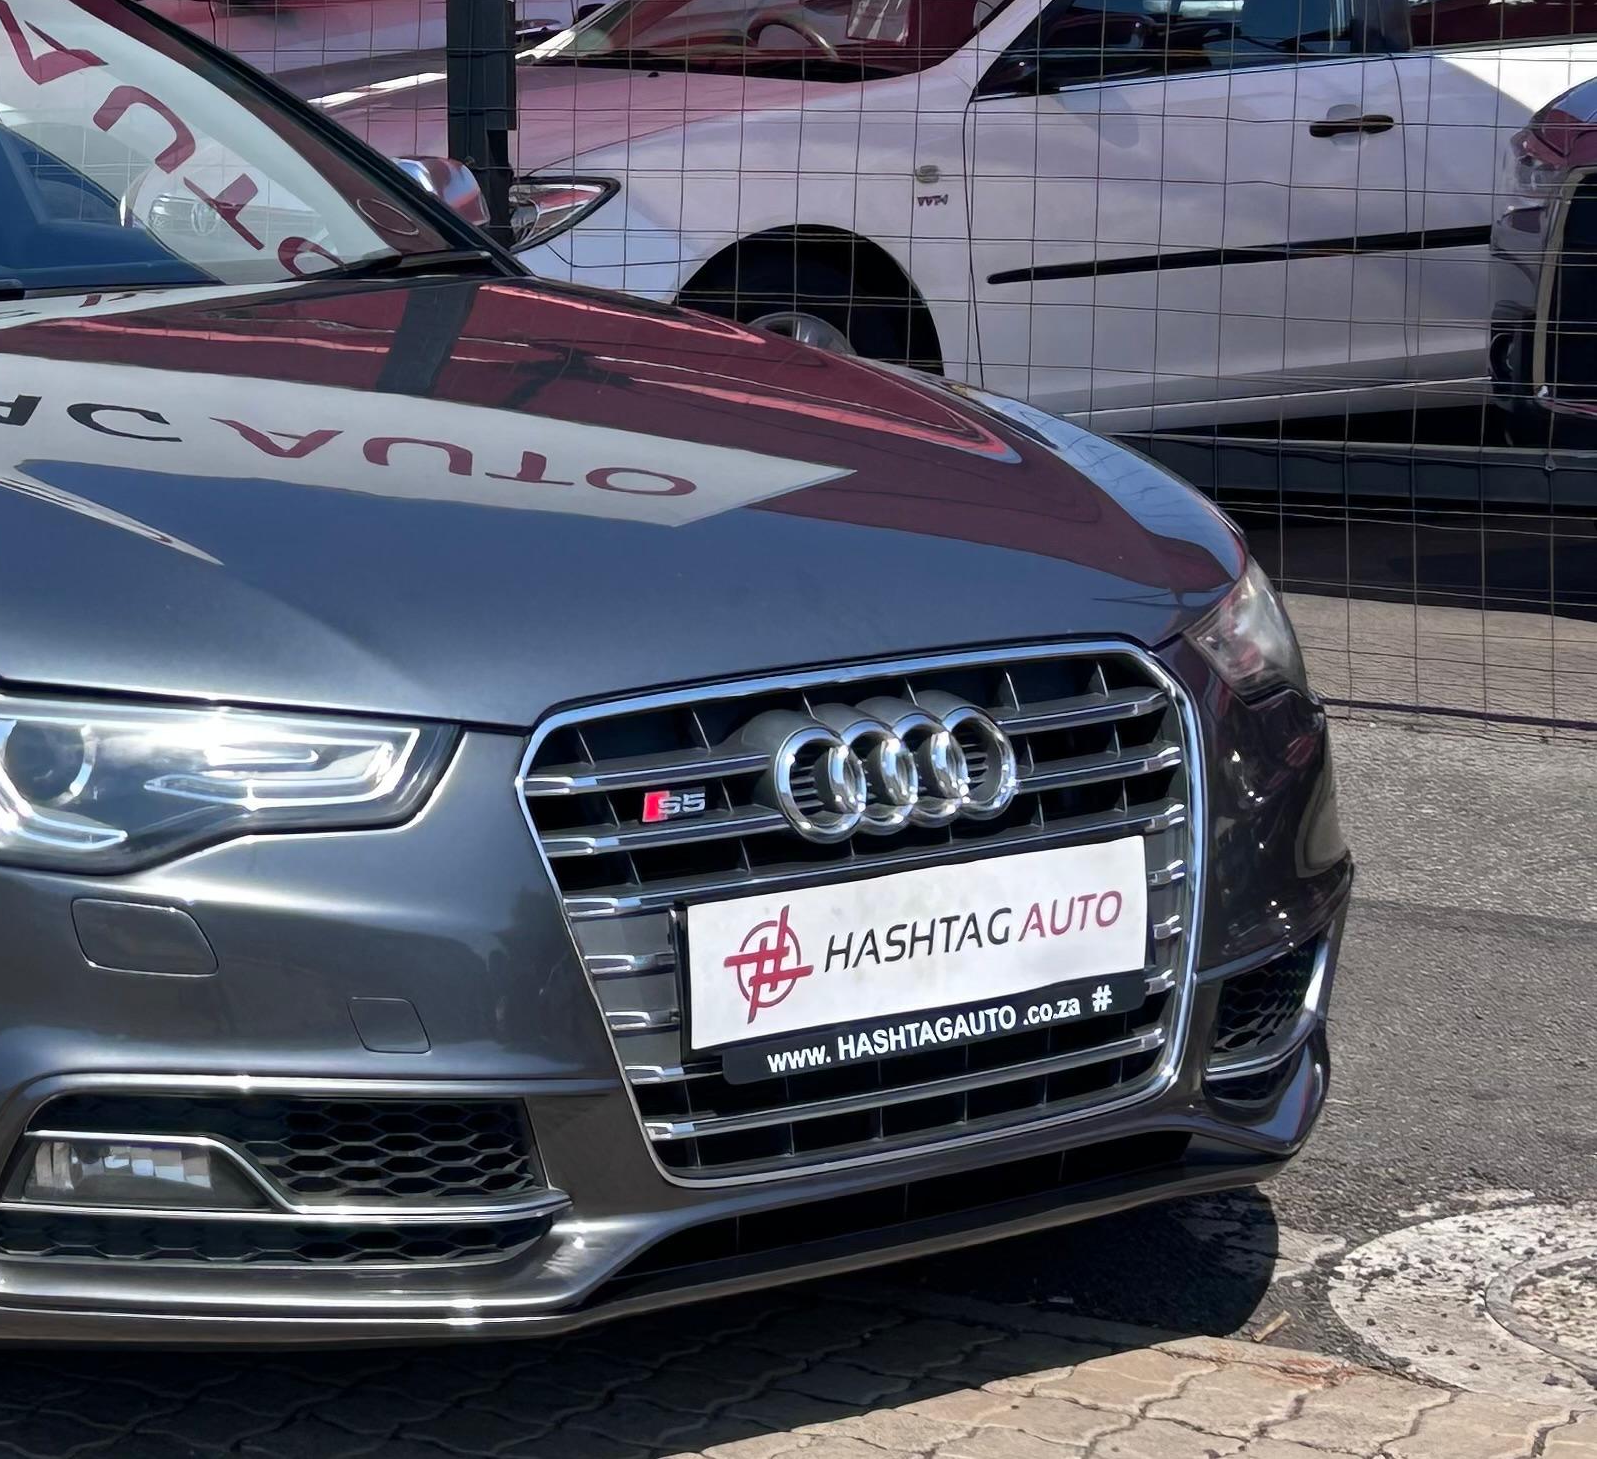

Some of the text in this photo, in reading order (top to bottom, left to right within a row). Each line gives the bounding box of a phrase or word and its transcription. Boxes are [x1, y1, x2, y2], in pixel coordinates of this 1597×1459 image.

[658, 793, 705, 814] S5
[825, 890, 1122, 972] HASHTAG AUTO
[767, 1045, 831, 1072] www.
[838, 1005, 1017, 1061] HASHTAGAUTO
[1023, 998, 1081, 1026] .co.za
